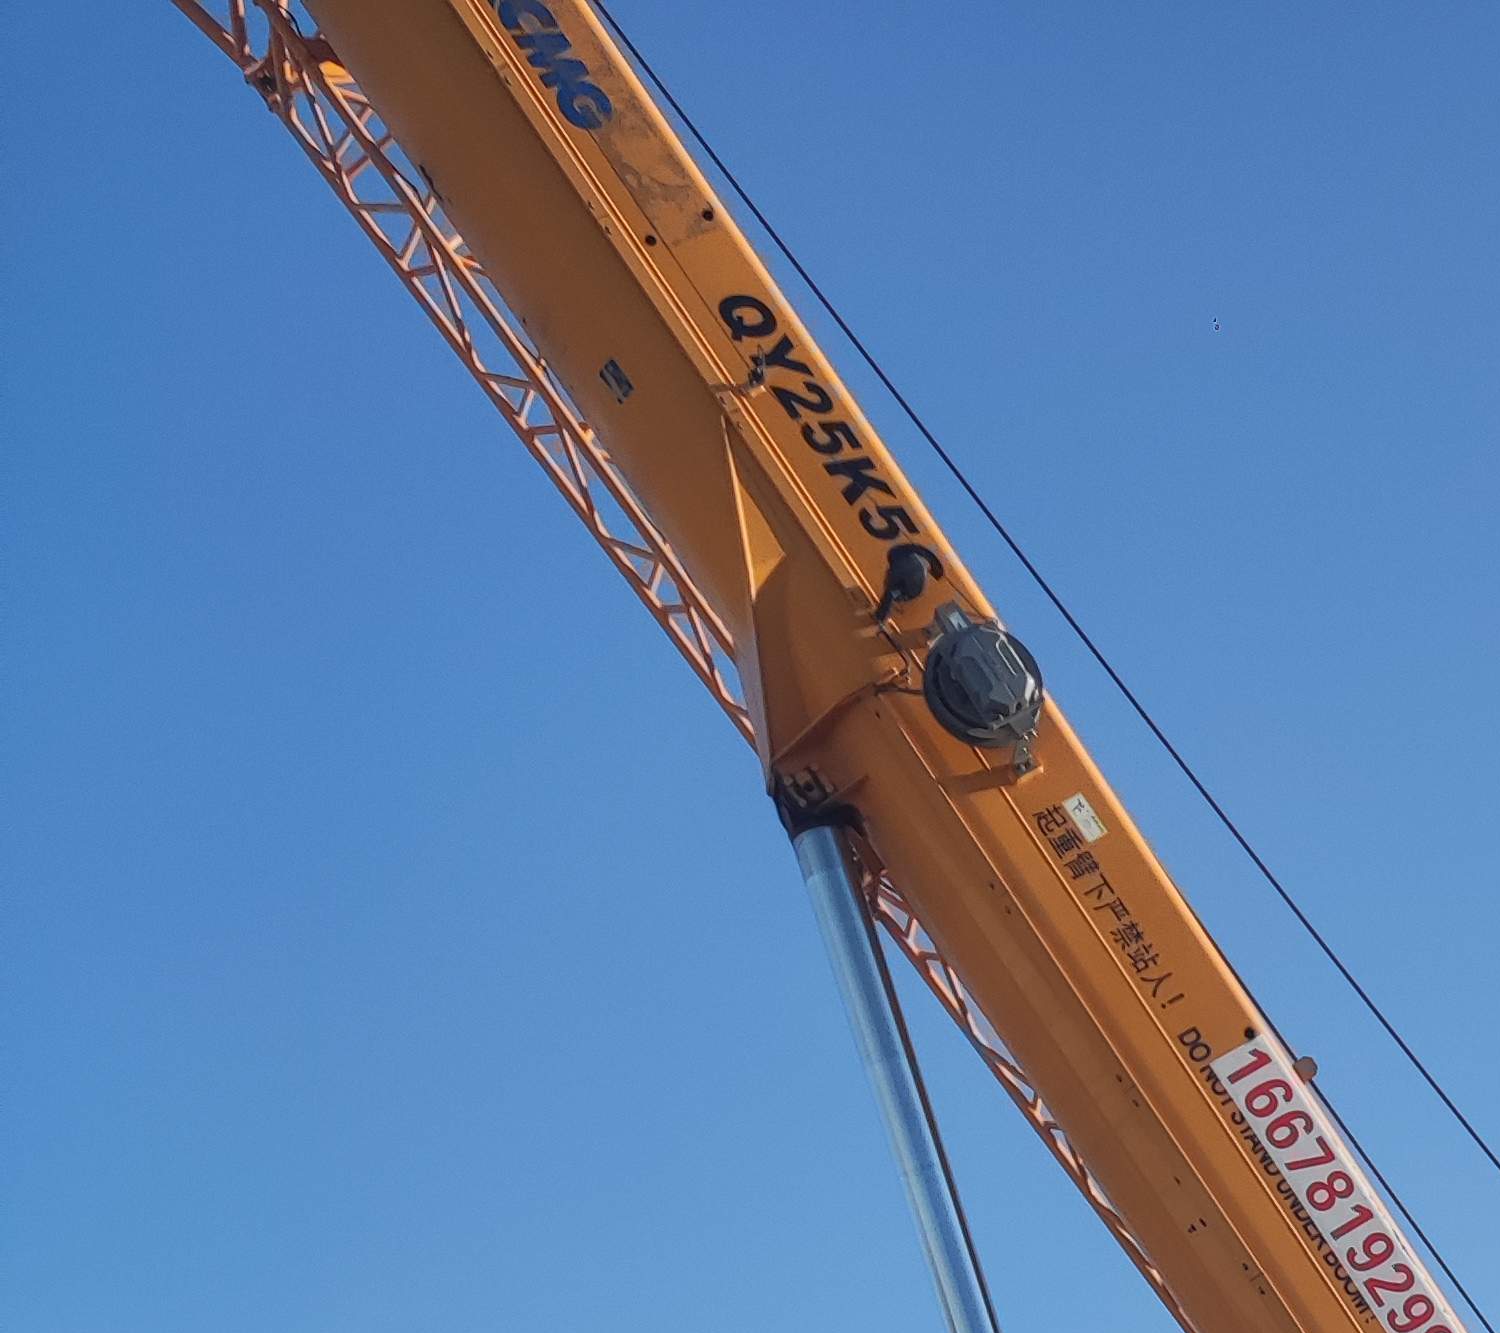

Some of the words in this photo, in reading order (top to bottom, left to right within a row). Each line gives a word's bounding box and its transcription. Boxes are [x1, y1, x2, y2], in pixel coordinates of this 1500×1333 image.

[489, 0, 613, 130] CMG
[1032, 803, 1185, 1009] 起重臂下严禁站人！
[1177, 1026, 1212, 1062] DO
